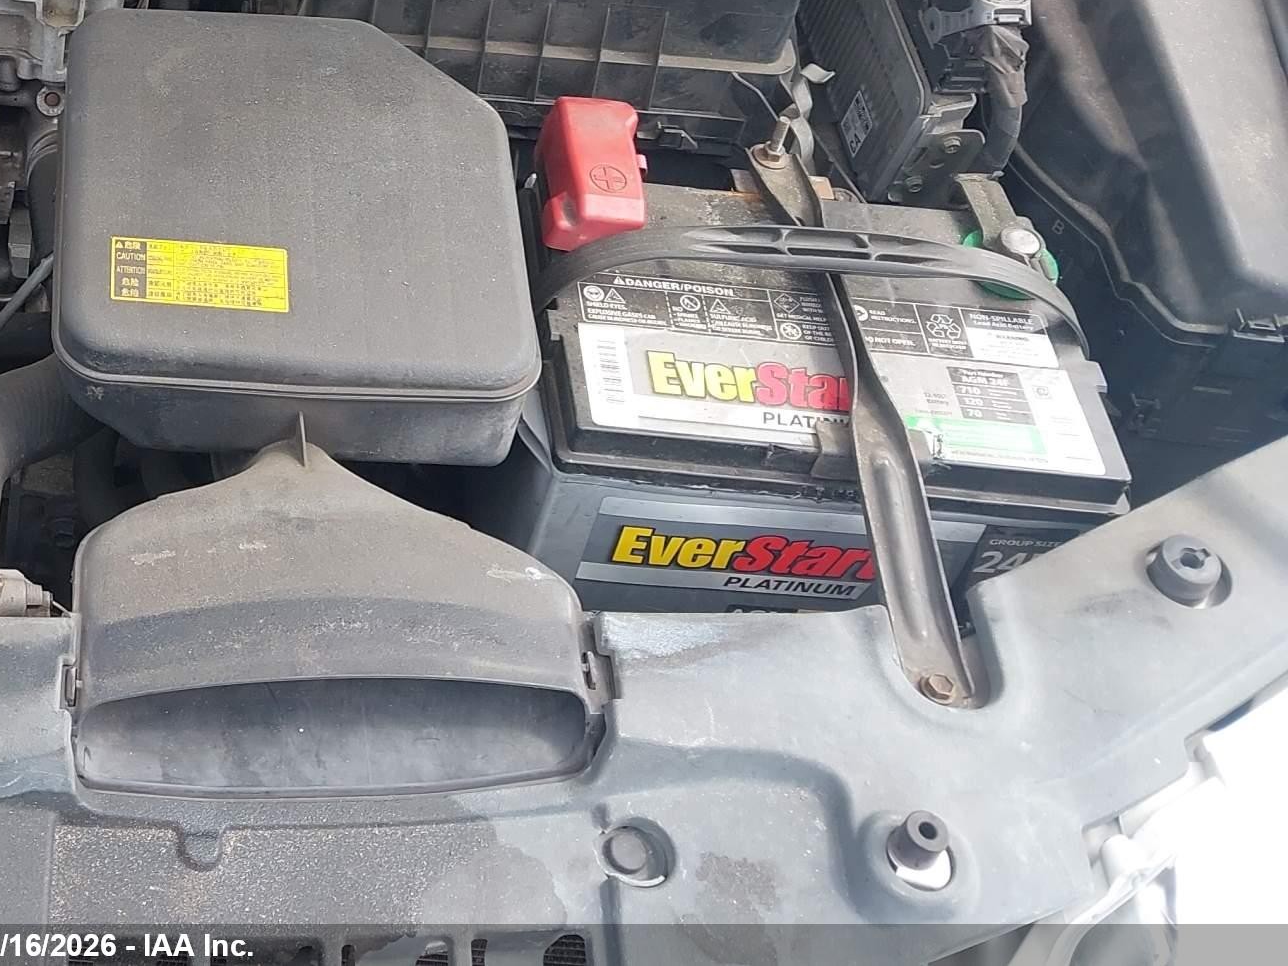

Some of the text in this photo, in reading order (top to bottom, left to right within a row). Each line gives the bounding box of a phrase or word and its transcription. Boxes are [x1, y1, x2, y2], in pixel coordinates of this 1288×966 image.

[116, 251, 146, 261] CAUTION
[116, 265, 146, 275] ATTENTION
[625, 278, 734, 296] DANGER/POISON
[969, 313, 1033, 325] NON-SPILLABLE
[962, 376, 988, 384] AGM
[959, 386, 982, 395] 710
[966, 409, 983, 418] 70
[989, 538, 1034, 547] GROUP
[723, 576, 856, 596] PLATINUM
